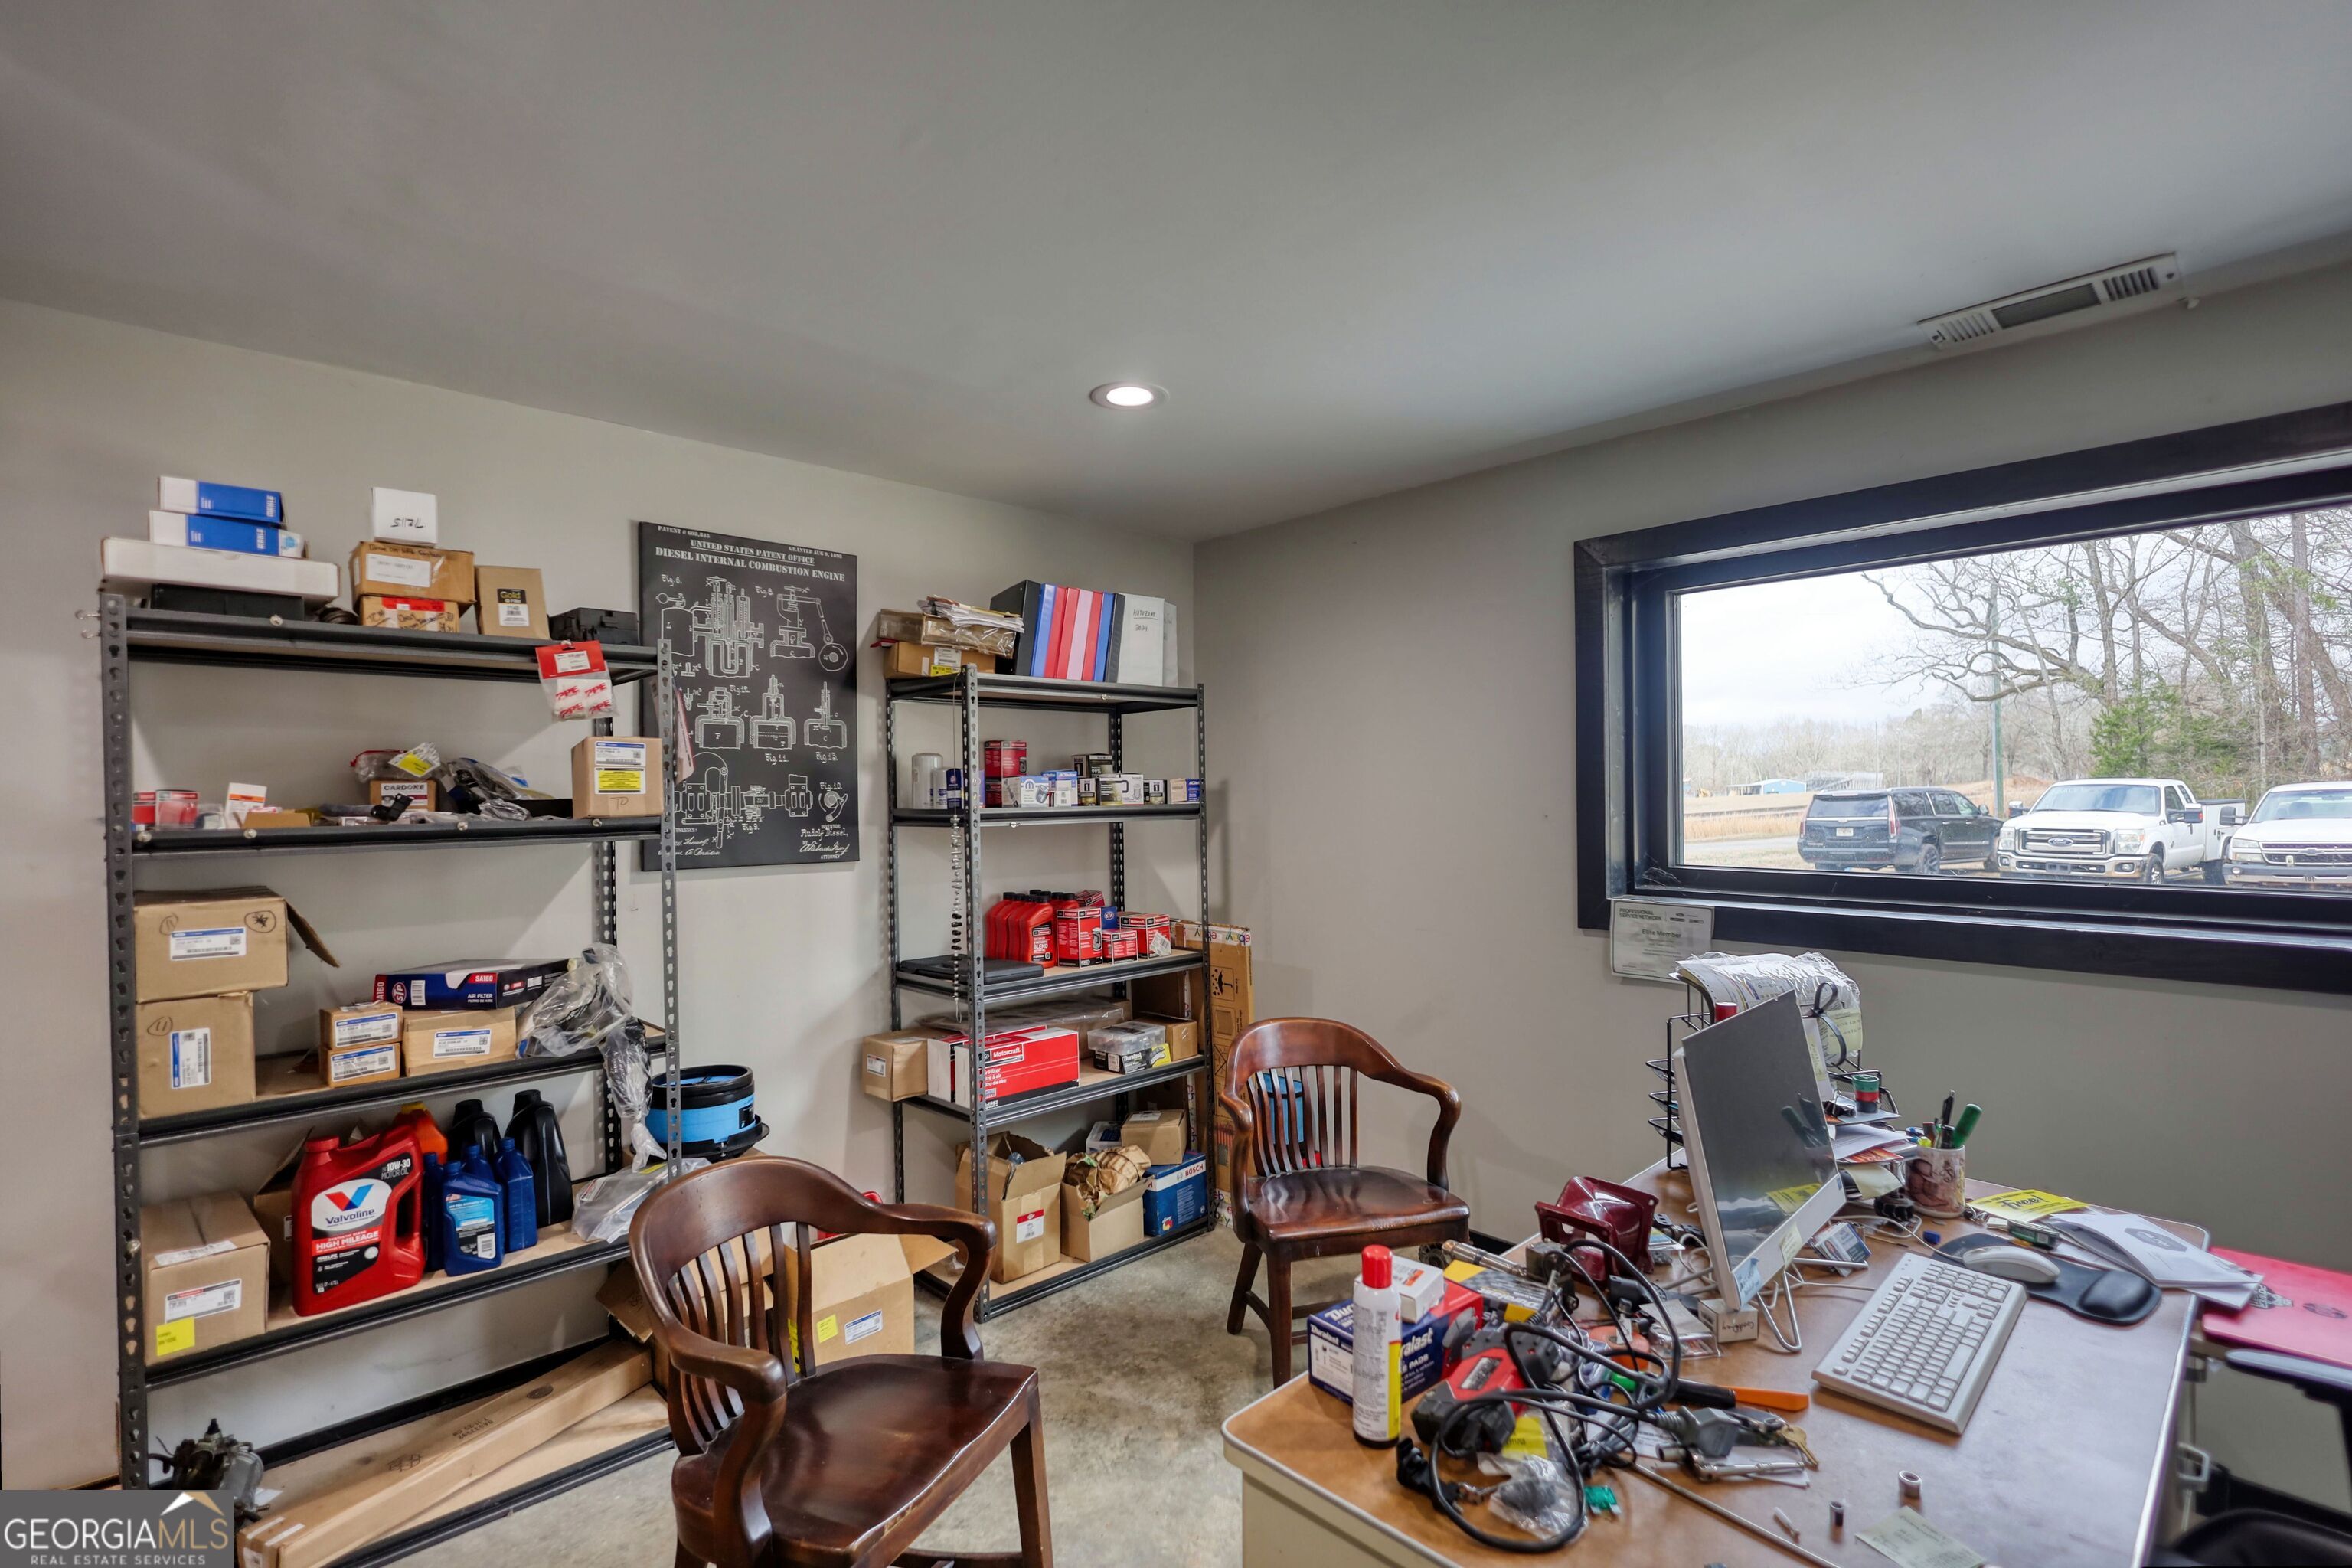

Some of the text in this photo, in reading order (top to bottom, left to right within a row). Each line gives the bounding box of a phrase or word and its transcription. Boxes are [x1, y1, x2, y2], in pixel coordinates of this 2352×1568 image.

[658, 525, 681, 534] PATENT
[690, 539, 815, 564] UNITED STATES PATENT OFFICE
[789, 546, 813, 554] GRANTED
[655, 547, 845, 582] DIESEL INTERNAL COMBUSTION ENGINE
[556, 685, 580, 700] PPE
[584, 682, 607, 697] PPE
[560, 703, 584, 718] PPE
[589, 700, 612, 714] PPE
[376, 982, 384, 1001] A160
[392, 982, 406, 1003] STP
[993, 1047, 1021, 1058] Motorcraft
[387, 1158, 411, 1172] 10W-30
[1184, 1163, 1204, 1177] BOSCH
[381, 1167, 409, 1180] MOTOR OIL
[1998, 1195, 2048, 1210] Free!
[325, 1208, 375, 1225] Valvoline
[316, 1230, 379, 1250] HIGH MILEAGE
[1310, 1323, 1339, 1347] Duralast
[1400, 1327, 1434, 1358] ralast
[1409, 1353, 1429, 1369] PADS
